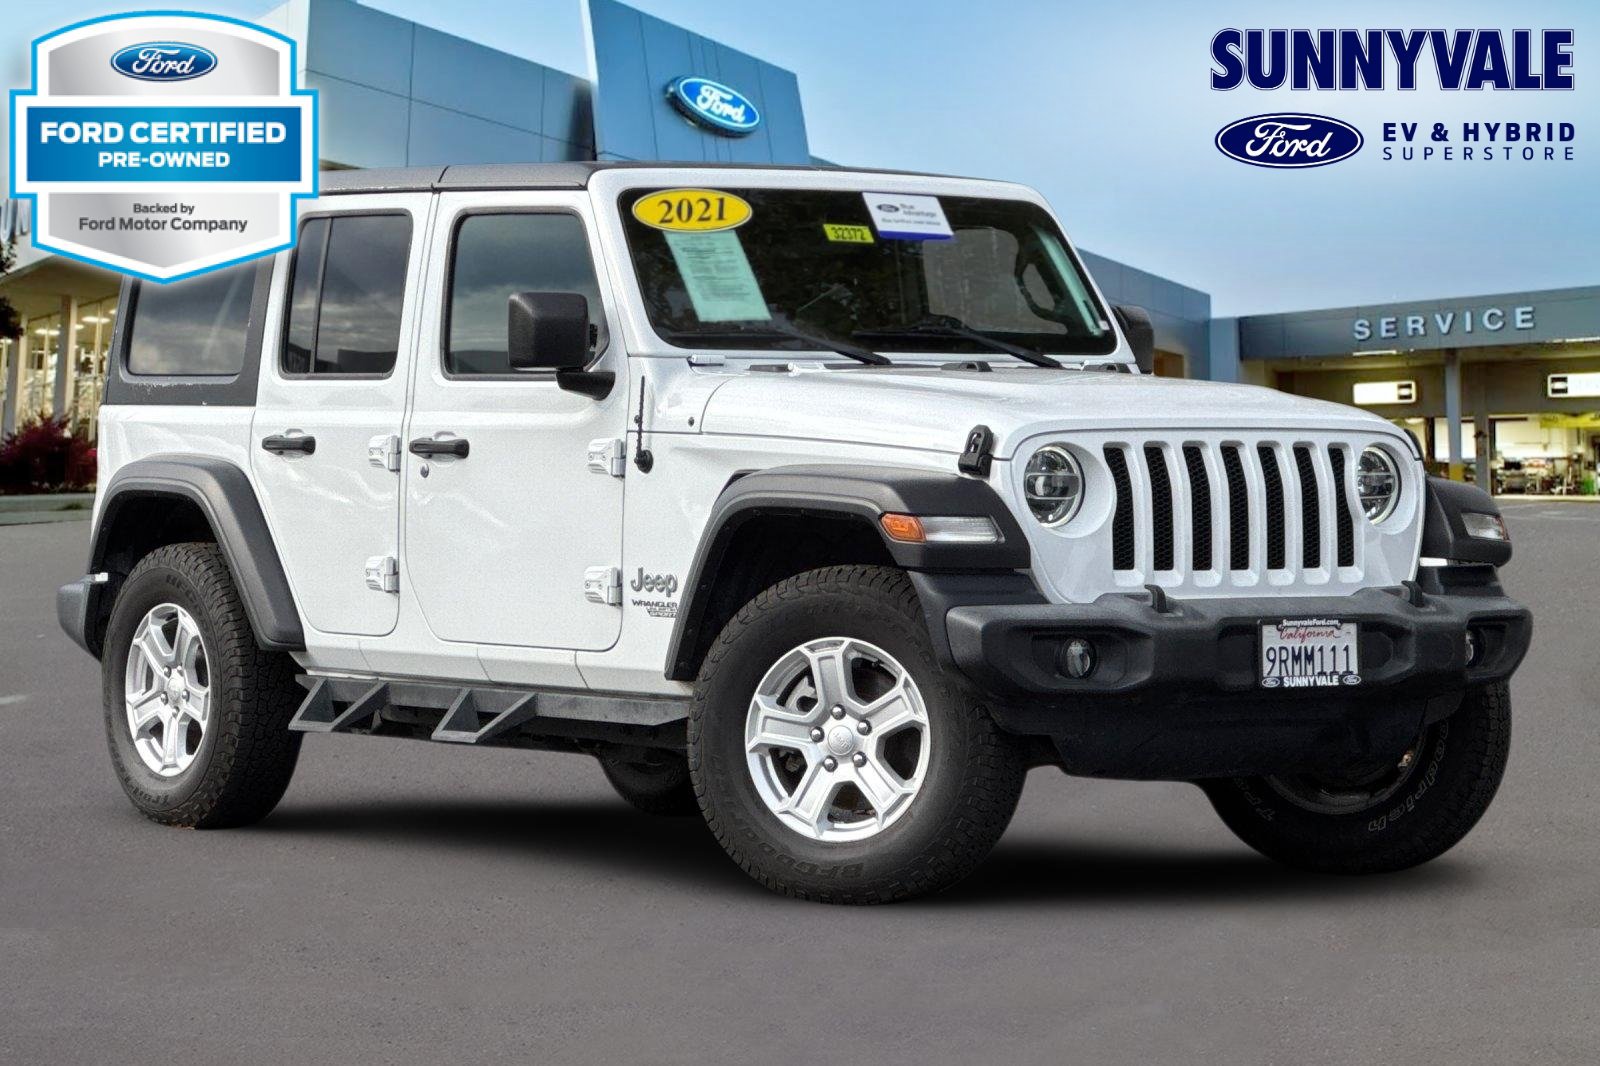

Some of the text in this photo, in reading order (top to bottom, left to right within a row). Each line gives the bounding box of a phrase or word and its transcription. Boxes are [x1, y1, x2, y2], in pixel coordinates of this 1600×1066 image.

[696, 84, 746, 123] Ford
[658, 197, 728, 225] 2021
[1353, 305, 1537, 342] SERVICE
[630, 566, 679, 598] Jeep
[631, 599, 678, 608] WRANGLER
[1280, 626, 1340, 644] California
[1282, 618, 1340, 627] SunnyvaleFord.com
[1266, 644, 1353, 676] 9RMM111
[1283, 676, 1340, 688] SUNNYVALE
